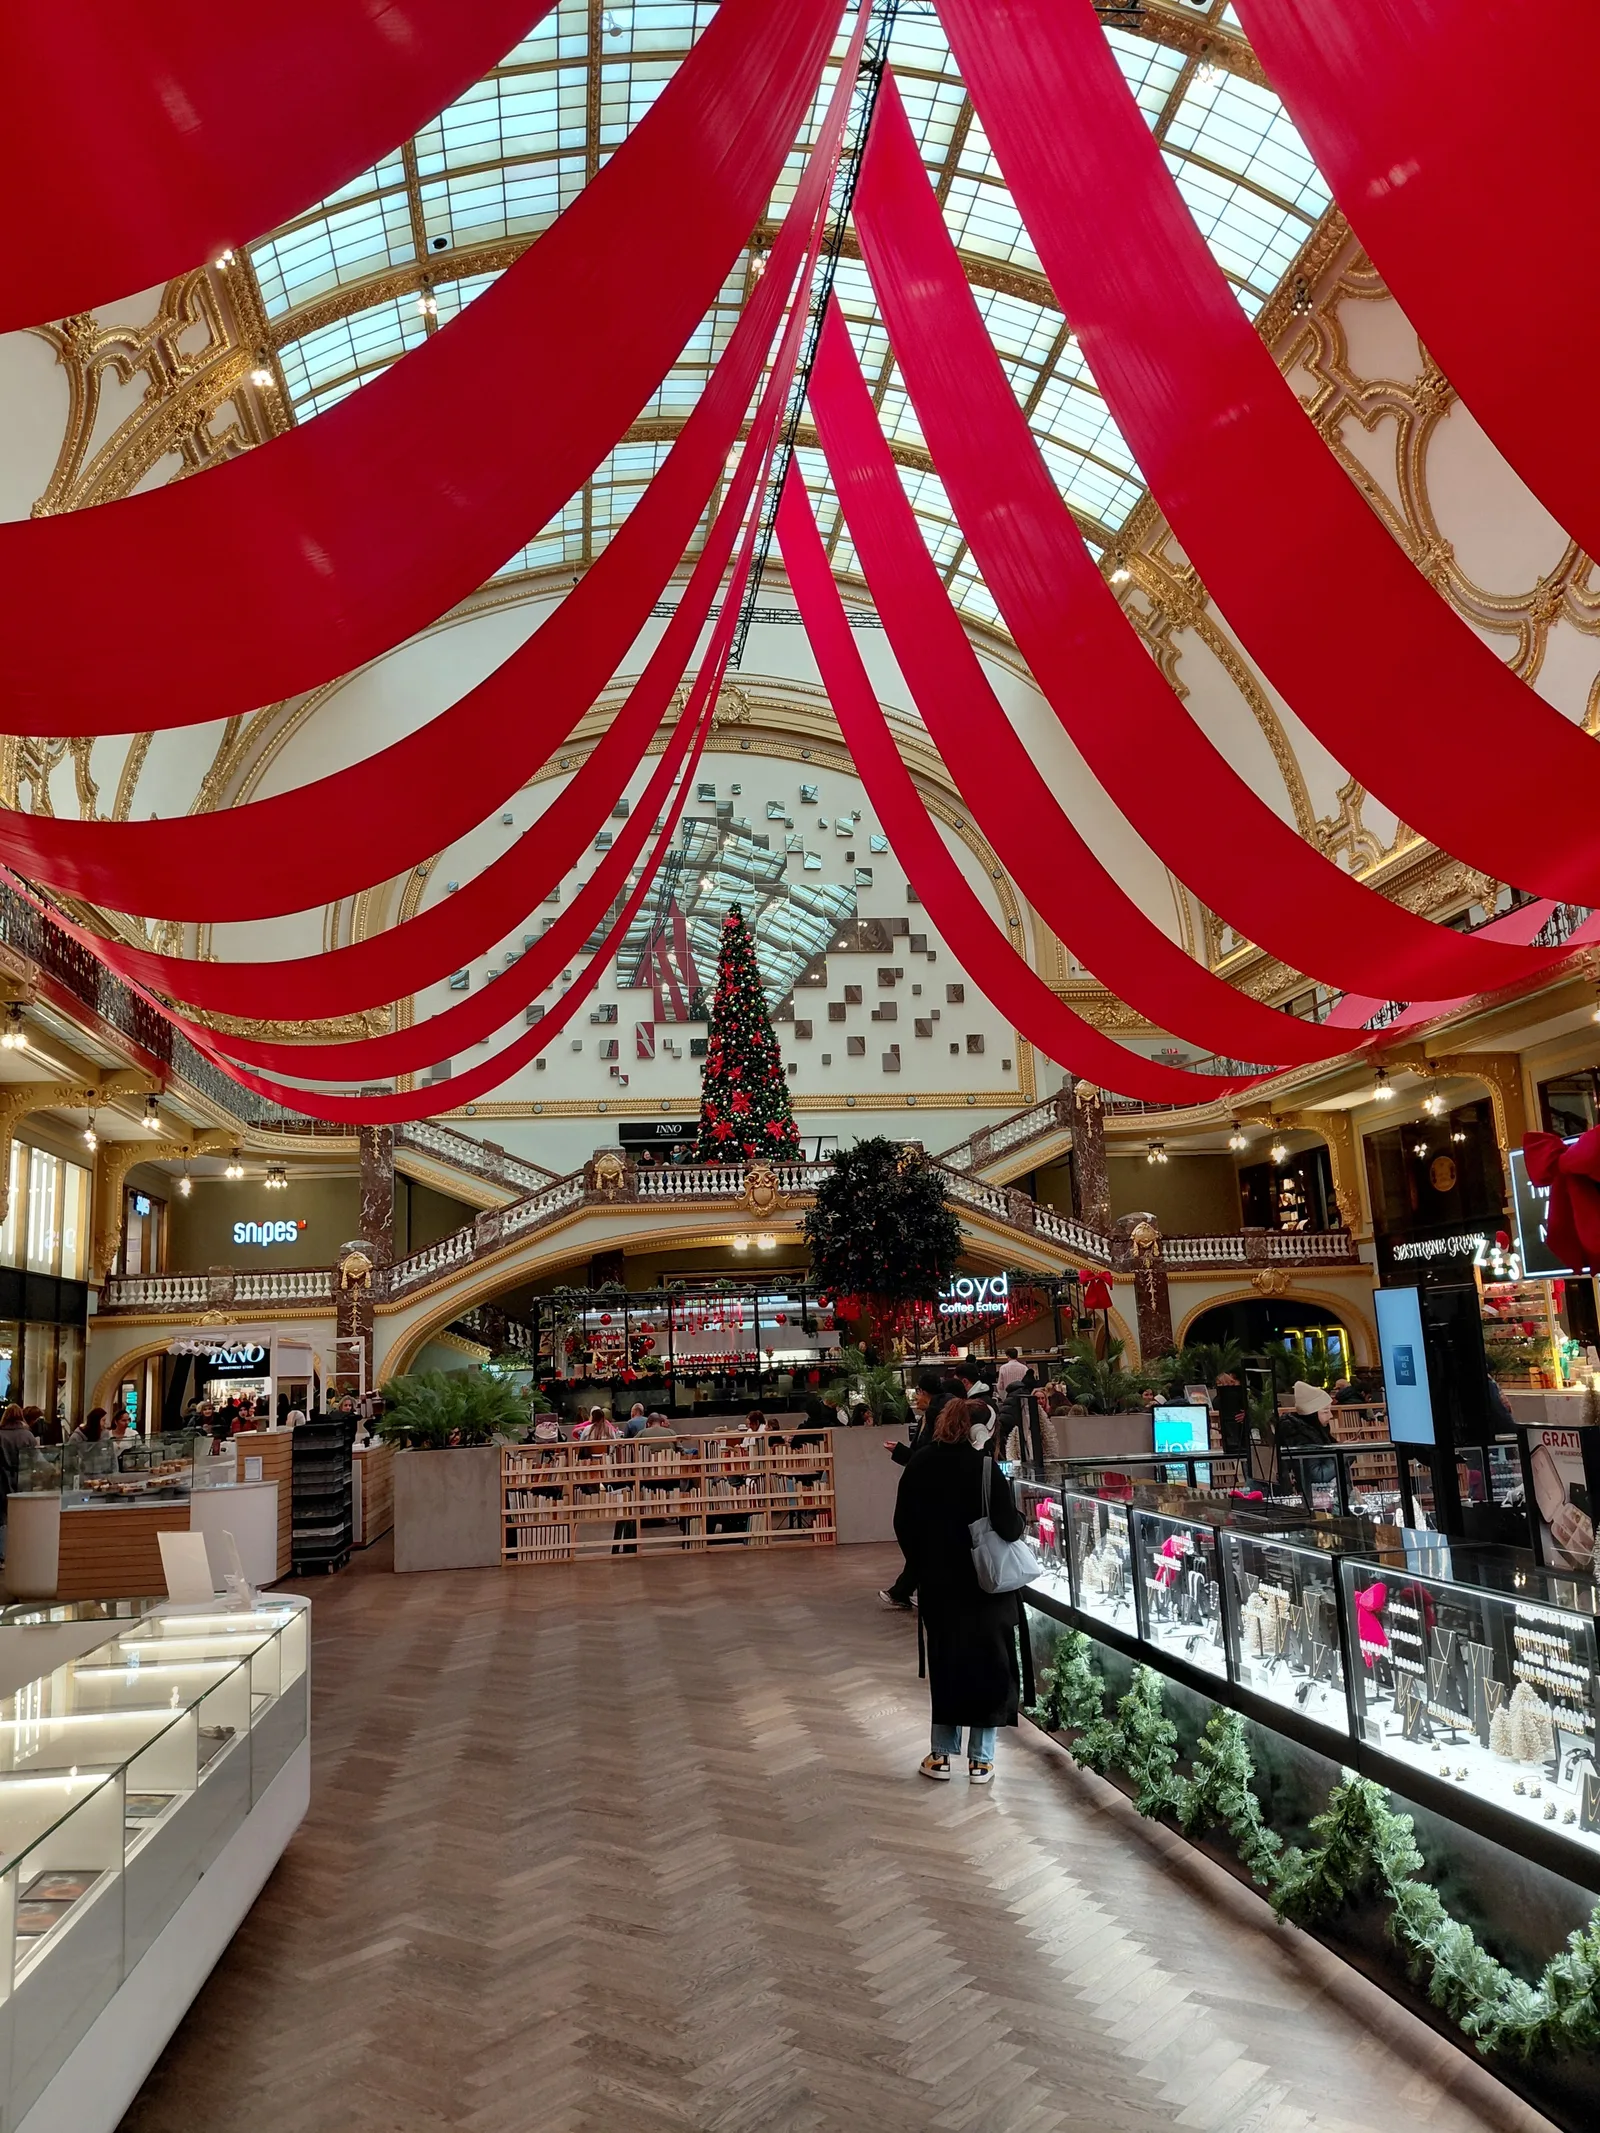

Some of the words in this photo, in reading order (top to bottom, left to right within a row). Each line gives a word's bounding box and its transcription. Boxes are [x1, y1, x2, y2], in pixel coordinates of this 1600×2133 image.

[656, 1124, 683, 1134] INNO
[233, 1220, 298, 1247] snipes
[939, 1303, 974, 1313] Coffee
[976, 1302, 1009, 1313] Eatery
[209, 1344, 265, 1364] INNO
